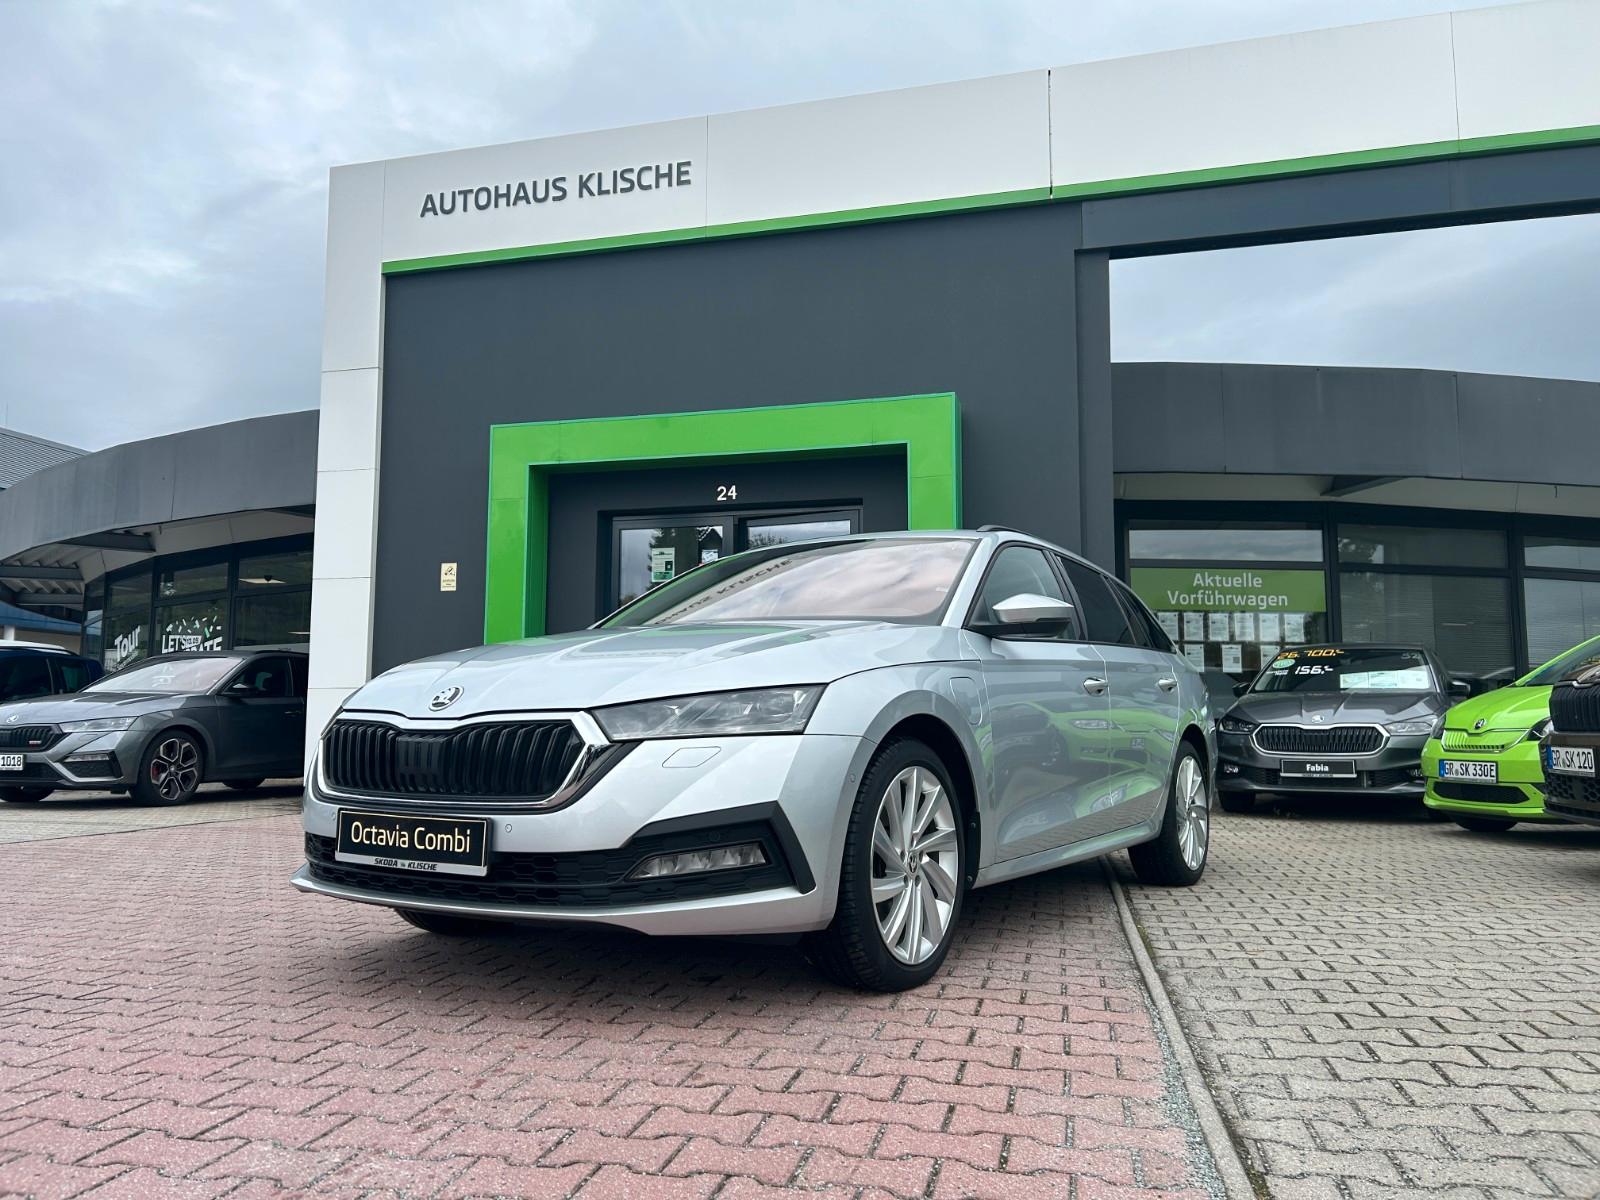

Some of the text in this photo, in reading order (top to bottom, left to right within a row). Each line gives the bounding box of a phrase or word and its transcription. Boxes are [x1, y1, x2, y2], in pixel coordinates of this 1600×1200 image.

[420, 161, 692, 218] AUTOHAUS KLISCHE
[717, 485, 738, 501] 24
[1193, 572, 1263, 588] Aktuelle
[1167, 590, 1288, 610] Vorführwagen
[114, 625, 141, 662] Tour
[1, 756, 22, 767] 1018
[1306, 763, 1329, 772] Fabia
[1551, 749, 1594, 770] GR SK 120
[1444, 762, 1495, 778] GR SK 330E
[351, 821, 471, 853] Octavia Combi
[407, 861, 438, 871] KLISCHE
